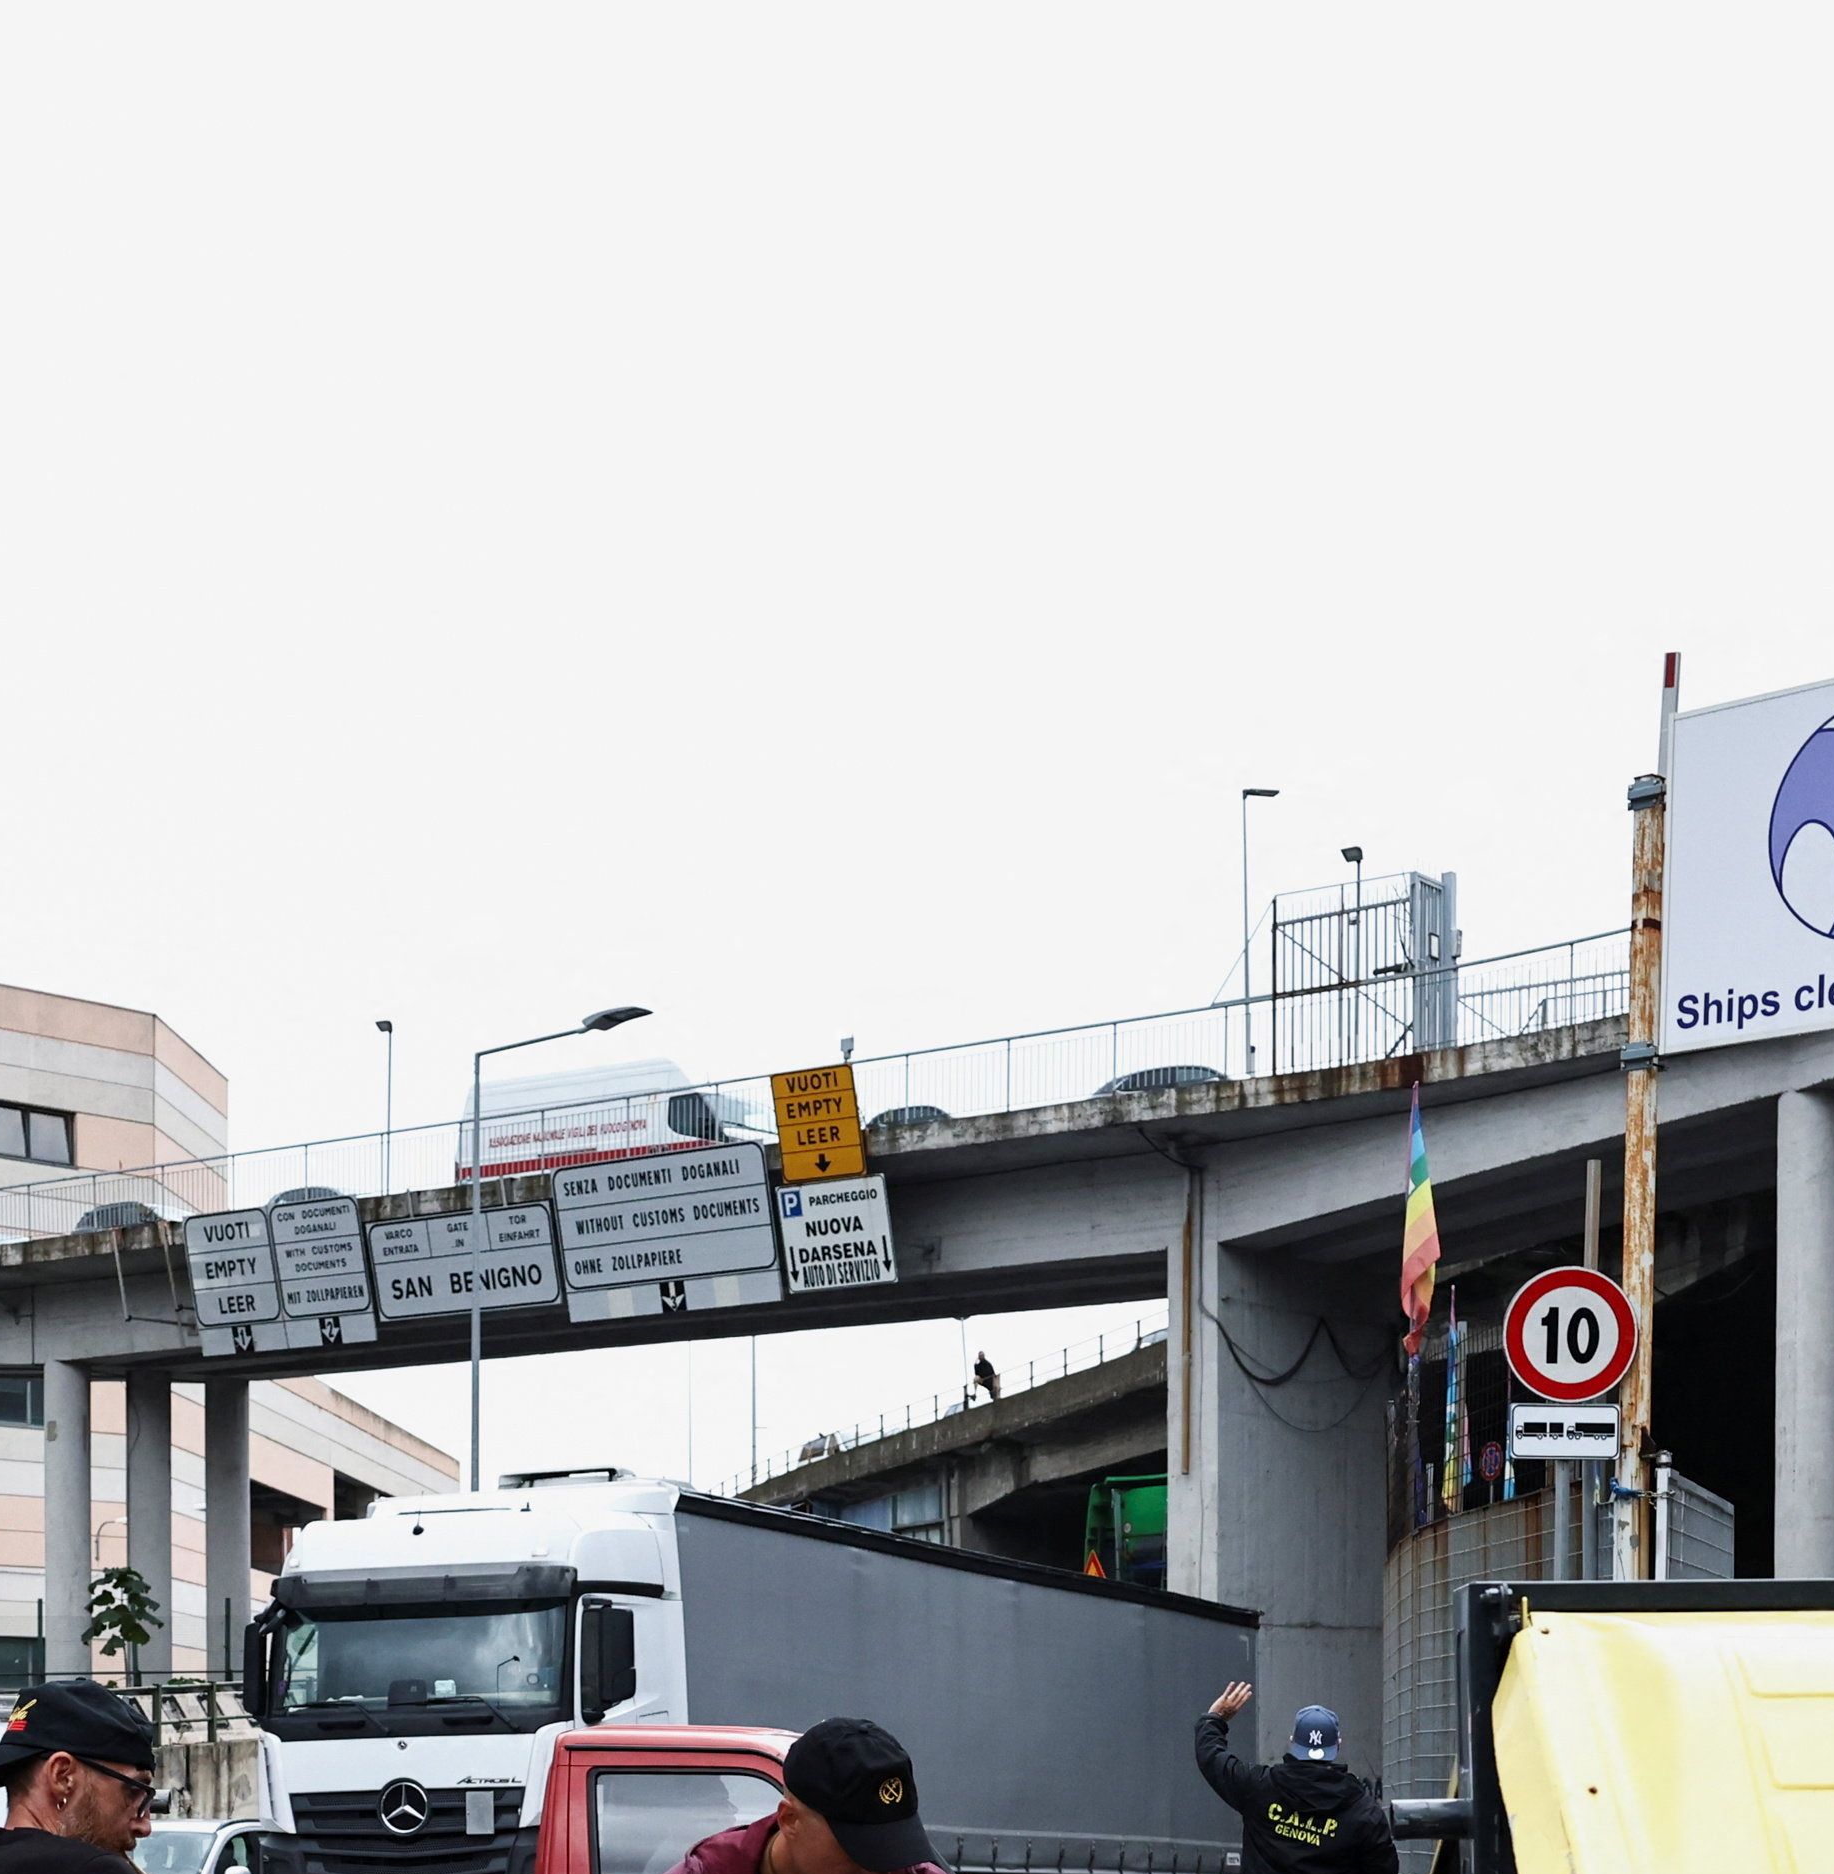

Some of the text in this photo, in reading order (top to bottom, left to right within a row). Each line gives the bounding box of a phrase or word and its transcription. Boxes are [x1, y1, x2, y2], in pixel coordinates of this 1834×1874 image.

[1674, 983, 1781, 1032] Ships
[786, 1071, 838, 1094] VUOTI
[787, 1097, 842, 1119] EMPTY
[797, 1125, 840, 1146] LEER
[563, 1158, 740, 1196] SENZA DOCUMENTI DOGANALI
[808, 1188, 877, 1207] PARCHEGGIO
[277, 1205, 350, 1222] CON DOCUMENTI
[508, 1215, 526, 1225] TOR
[575, 1198, 760, 1235] WITHOUT CUSTOMS DOCUMENTS
[204, 1221, 249, 1243] VUOTI
[294, 1222, 336, 1235] DOGANALI
[384, 1229, 413, 1240] VARCO
[447, 1222, 469, 1233] GATE
[499, 1229, 540, 1243] EINFAHRT
[805, 1216, 864, 1238] NUOVA
[285, 1242, 353, 1258] WITH CUSTOMS
[383, 1244, 419, 1257] ENTRATA
[799, 1240, 877, 1264] DARSENA
[205, 1257, 256, 1280] EMPTY
[295, 1258, 347, 1273] DOCUMENTS
[574, 1249, 683, 1276] OHNE ZOLLPAPIERE
[802, 1258, 881, 1288] AUTO DI SERVIZIO
[391, 1264, 542, 1300] SAN BENIGNO
[219, 1295, 256, 1314] LEER
[287, 1285, 364, 1304] MIT ZOLLPAPIEREN
[1541, 1307, 1600, 1364] 10
[1268, 1803, 1338, 1837] C.A.L.P.
[1275, 1824, 1321, 1847] GENOVA
